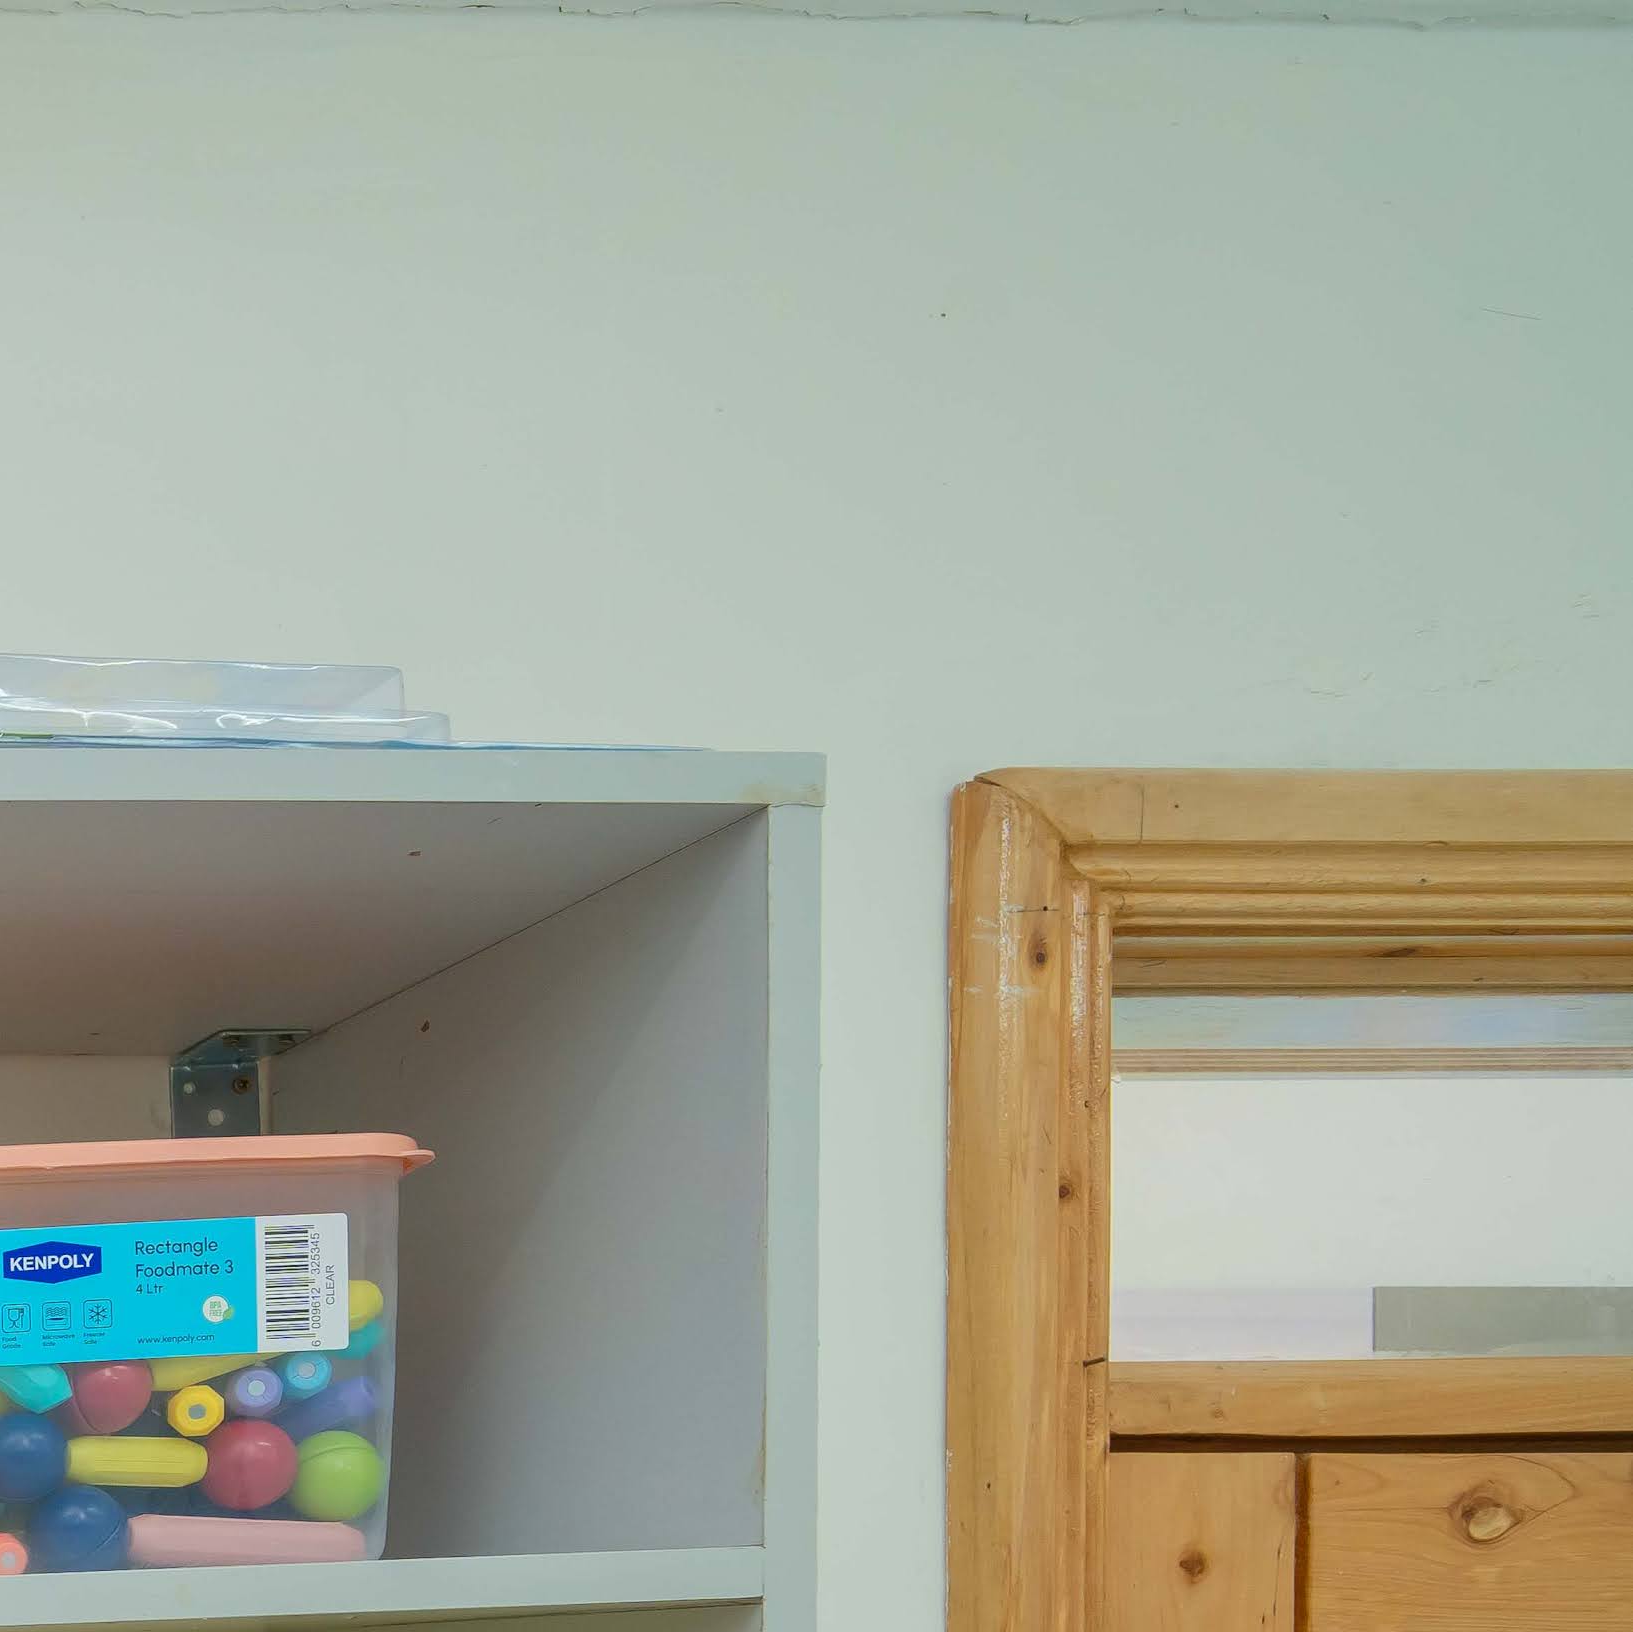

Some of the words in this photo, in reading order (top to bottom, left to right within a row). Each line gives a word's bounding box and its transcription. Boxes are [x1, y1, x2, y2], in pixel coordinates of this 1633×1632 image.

[135, 1236, 218, 1257] Rectangle
[310, 1232, 320, 1275] 325345
[9, 1252, 94, 1272] KENPOLY
[135, 1261, 219, 1278] Foodmate
[224, 1259, 233, 1274] 3
[135, 1284, 143, 1294] 4
[146, 1283, 163, 1294] Ltr
[325, 1264, 335, 1305] CLEAR
[311, 1287, 321, 1329] 009612
[137, 1333, 214, 1344] www.kenpoly.com
